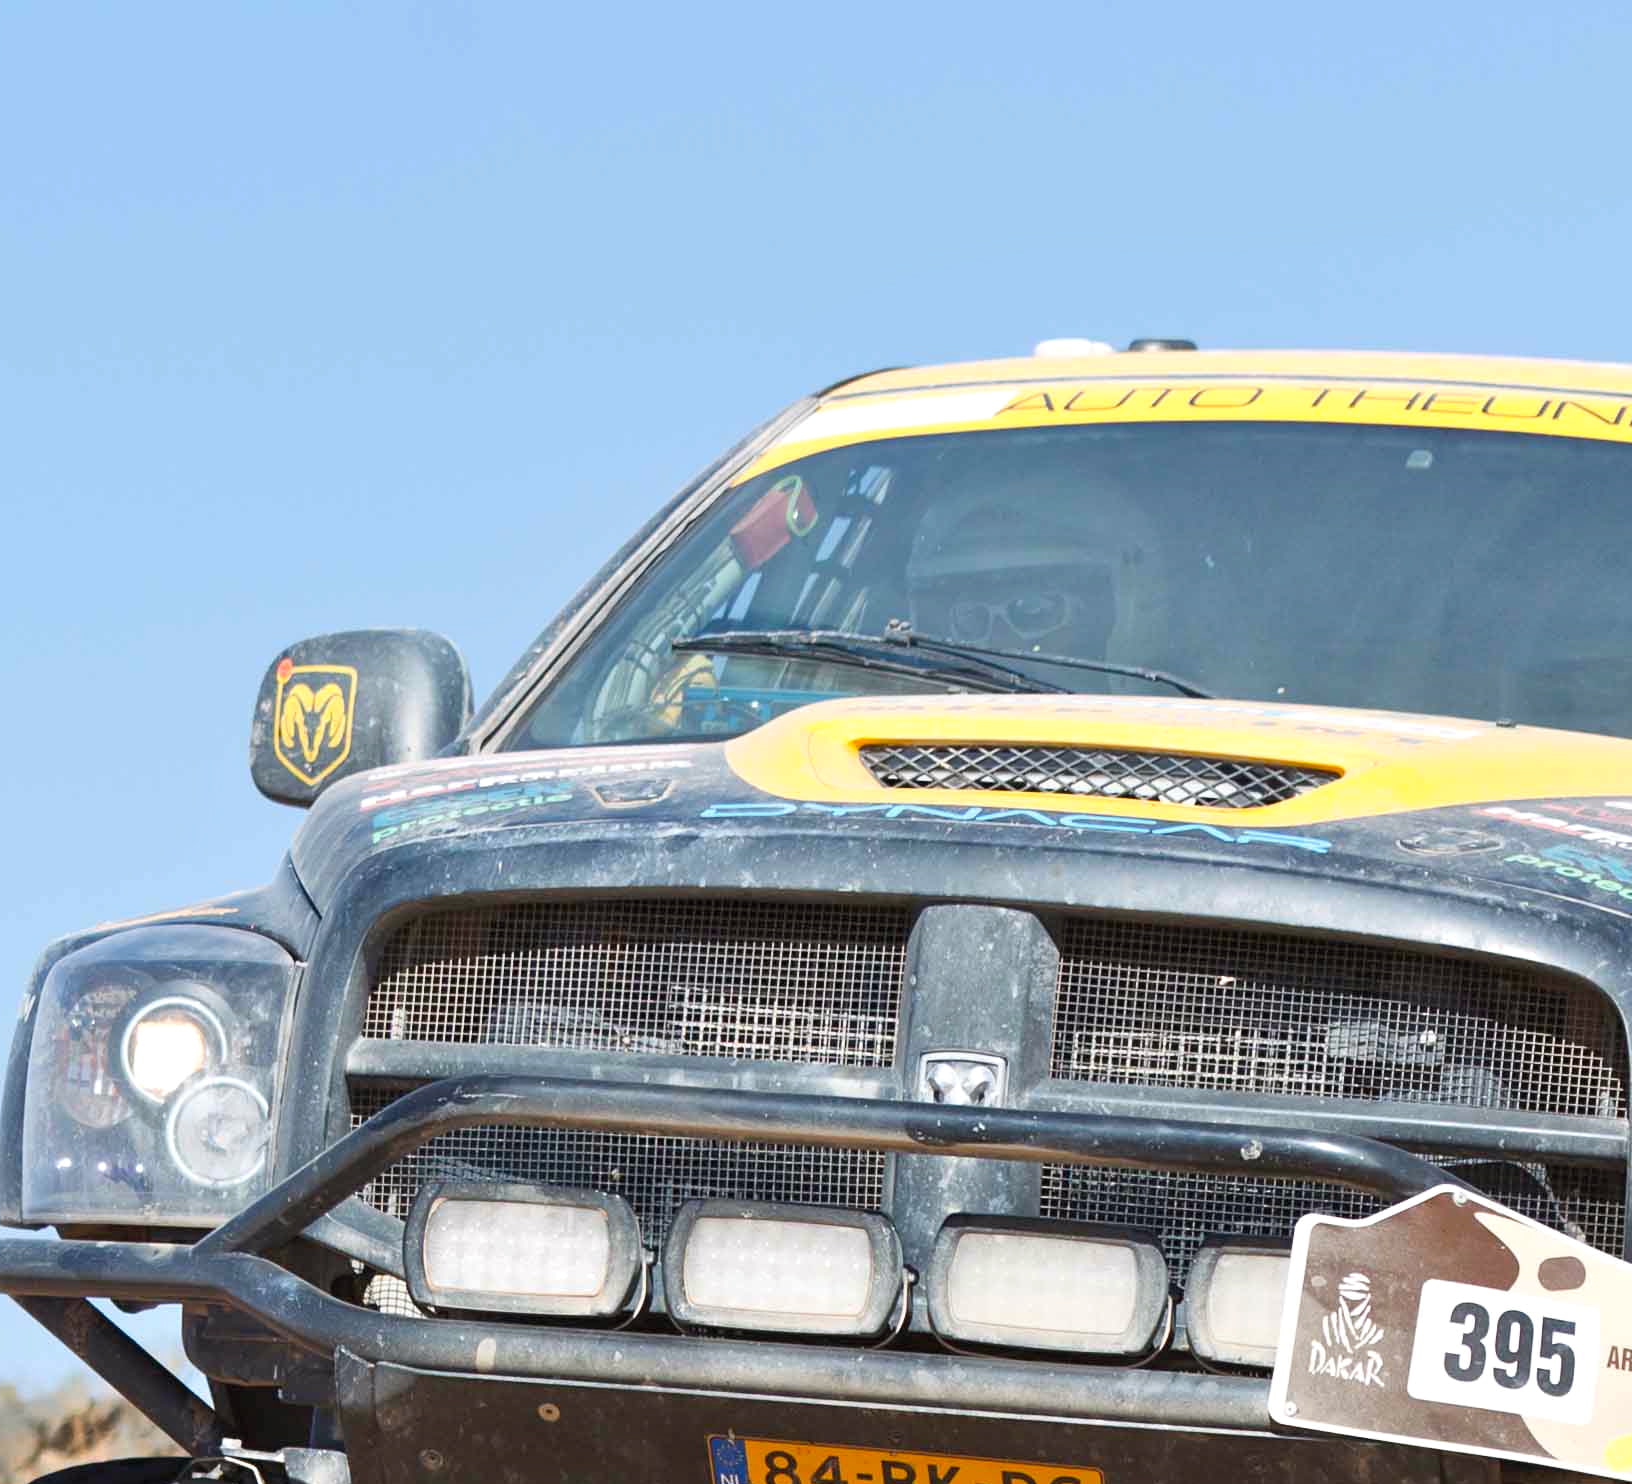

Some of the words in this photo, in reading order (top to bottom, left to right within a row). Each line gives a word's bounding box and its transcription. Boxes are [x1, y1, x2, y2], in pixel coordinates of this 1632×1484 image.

[994, 386, 1265, 417] AUTO
[1307, 1340, 1386, 1388] DAKAR
[1442, 1300, 1578, 1398] 395
